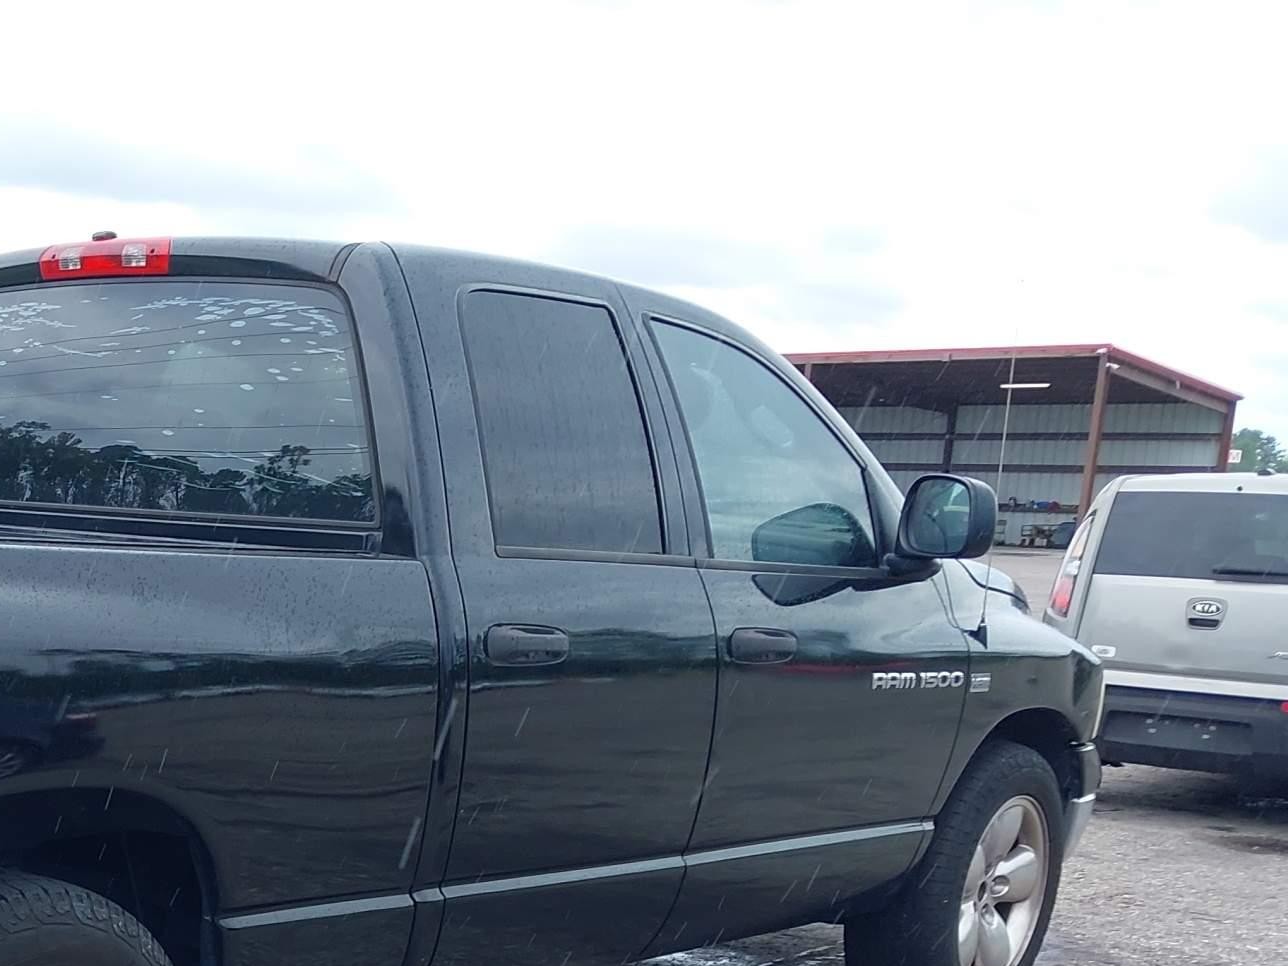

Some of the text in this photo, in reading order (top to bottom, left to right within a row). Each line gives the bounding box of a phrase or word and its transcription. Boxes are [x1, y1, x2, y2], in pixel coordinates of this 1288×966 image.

[1194, 603, 1218, 613] KIA
[872, 672, 916, 690] RAM
[919, 671, 964, 688] 1500
